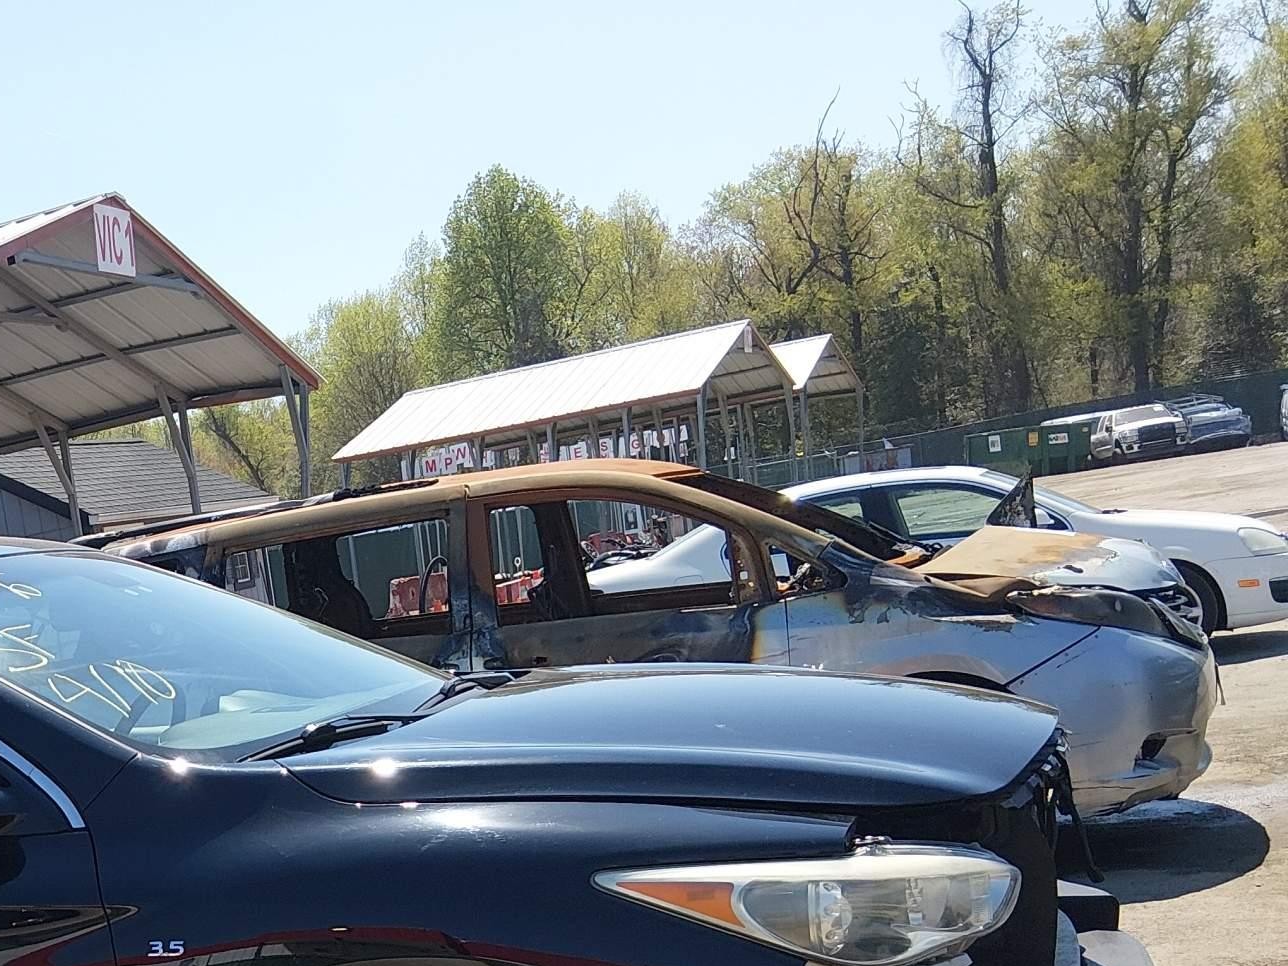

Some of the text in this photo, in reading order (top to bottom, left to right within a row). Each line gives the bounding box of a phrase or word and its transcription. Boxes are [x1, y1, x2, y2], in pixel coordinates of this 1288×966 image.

[94, 212, 134, 267] VIC 1
[573, 446, 583, 459] E
[600, 441, 609, 452] S
[425, 458, 437, 474] M
[444, 457, 453, 471] P
[147, 940, 186, 957] 3.5
